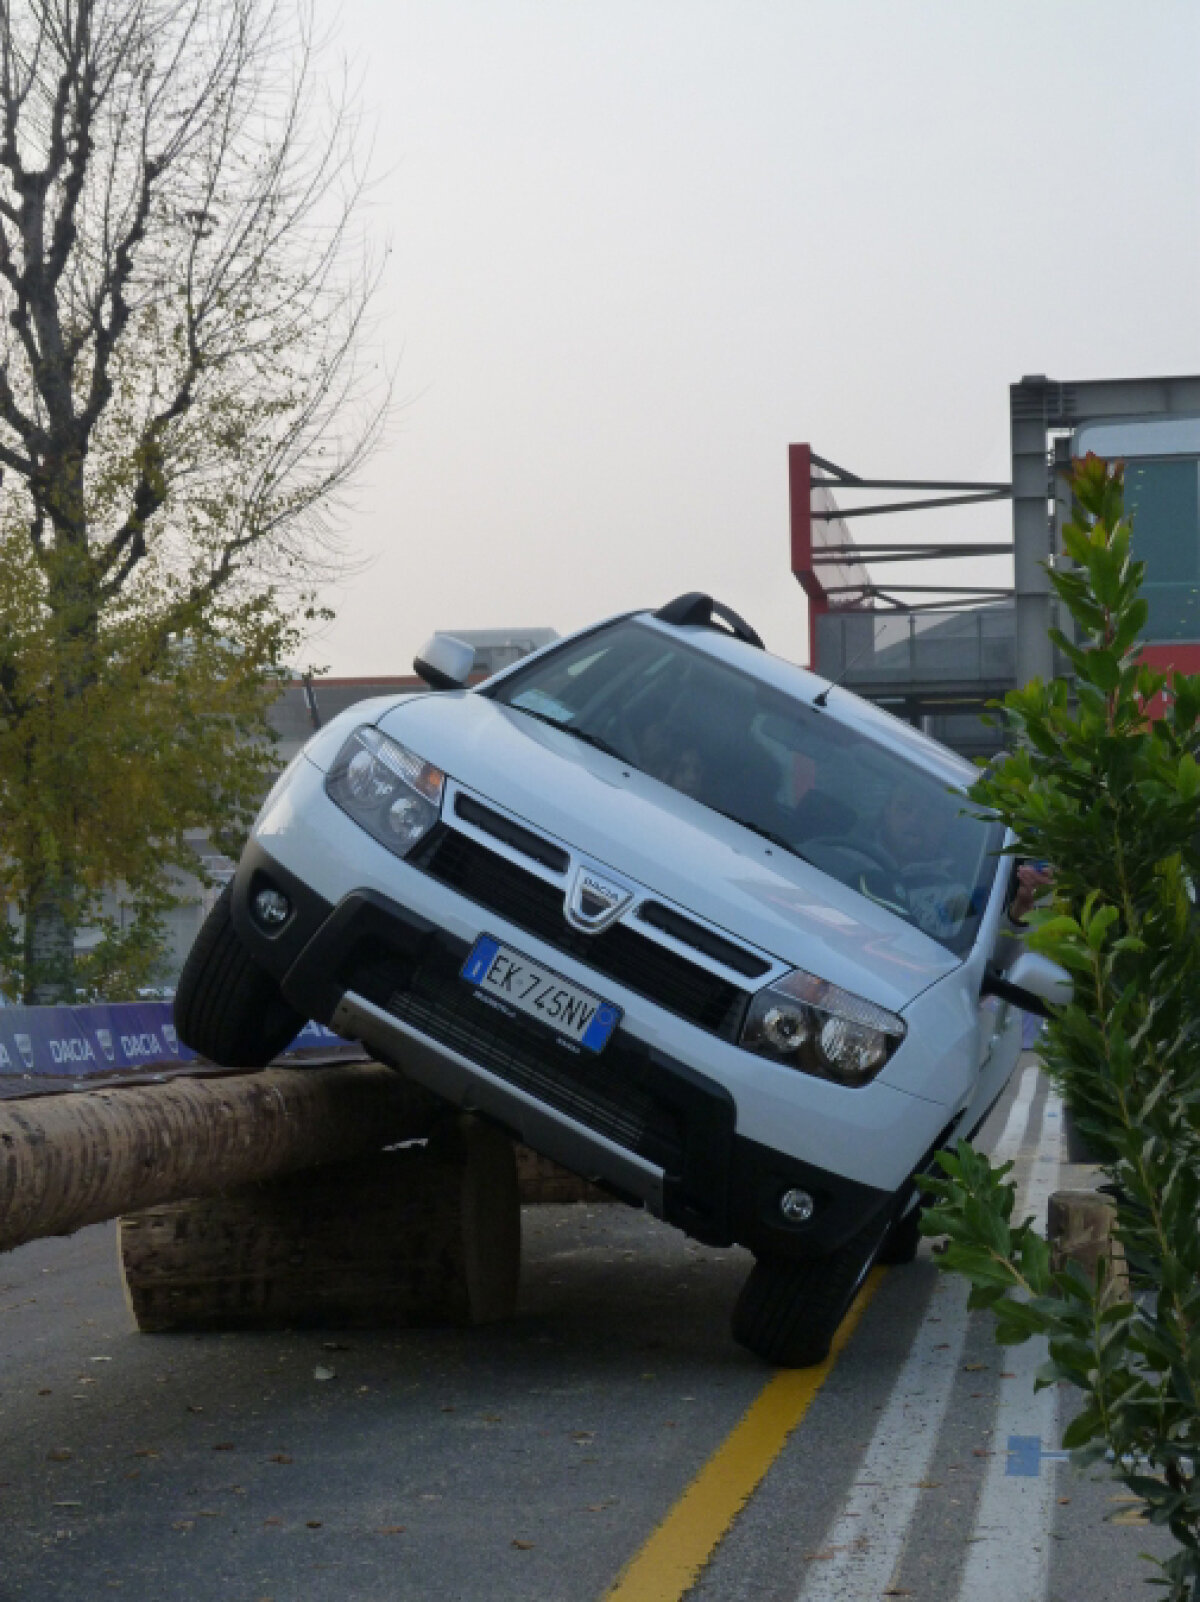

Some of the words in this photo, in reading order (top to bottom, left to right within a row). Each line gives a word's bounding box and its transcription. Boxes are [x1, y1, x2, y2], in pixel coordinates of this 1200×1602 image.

[486, 954, 523, 992] EK
[49, 1038, 96, 1064] DACIA
[120, 1033, 162, 1057] DACIA
